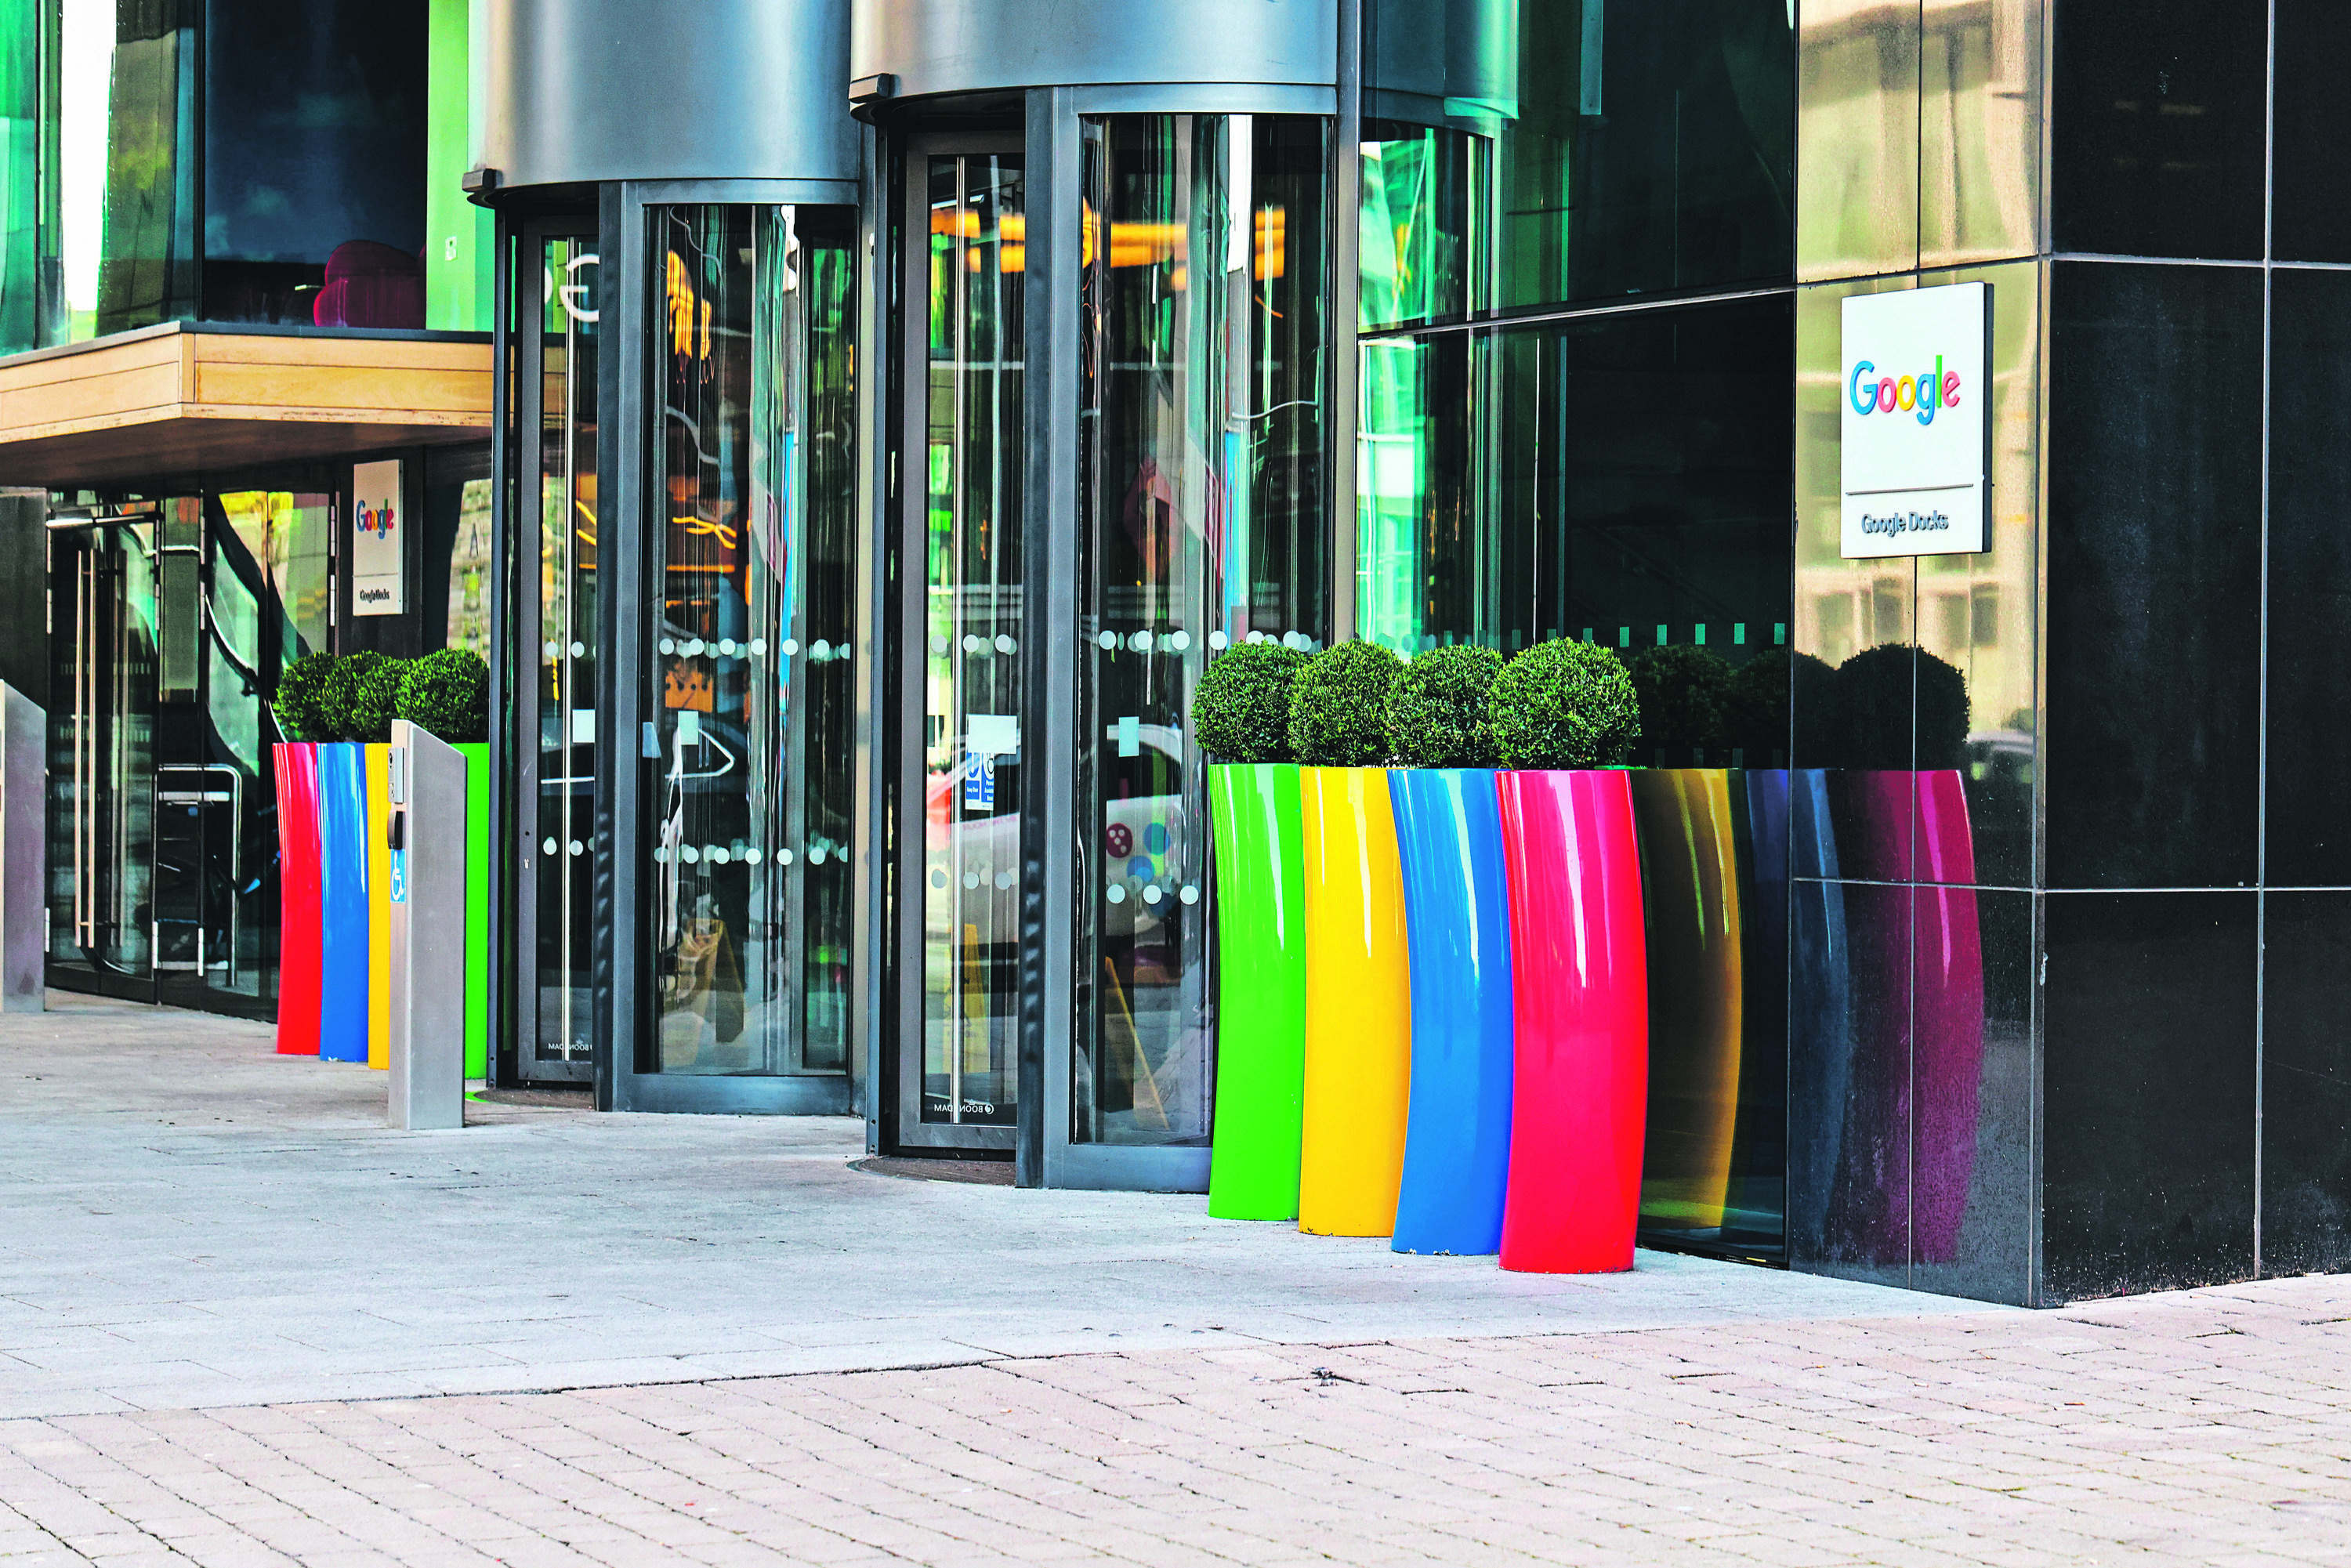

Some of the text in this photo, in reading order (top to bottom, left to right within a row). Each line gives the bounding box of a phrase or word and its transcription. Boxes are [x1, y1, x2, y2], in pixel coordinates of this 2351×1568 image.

[1849, 355, 1961, 425] Google
[356, 498, 394, 540] Google
[1861, 509, 1949, 538] Google Docks
